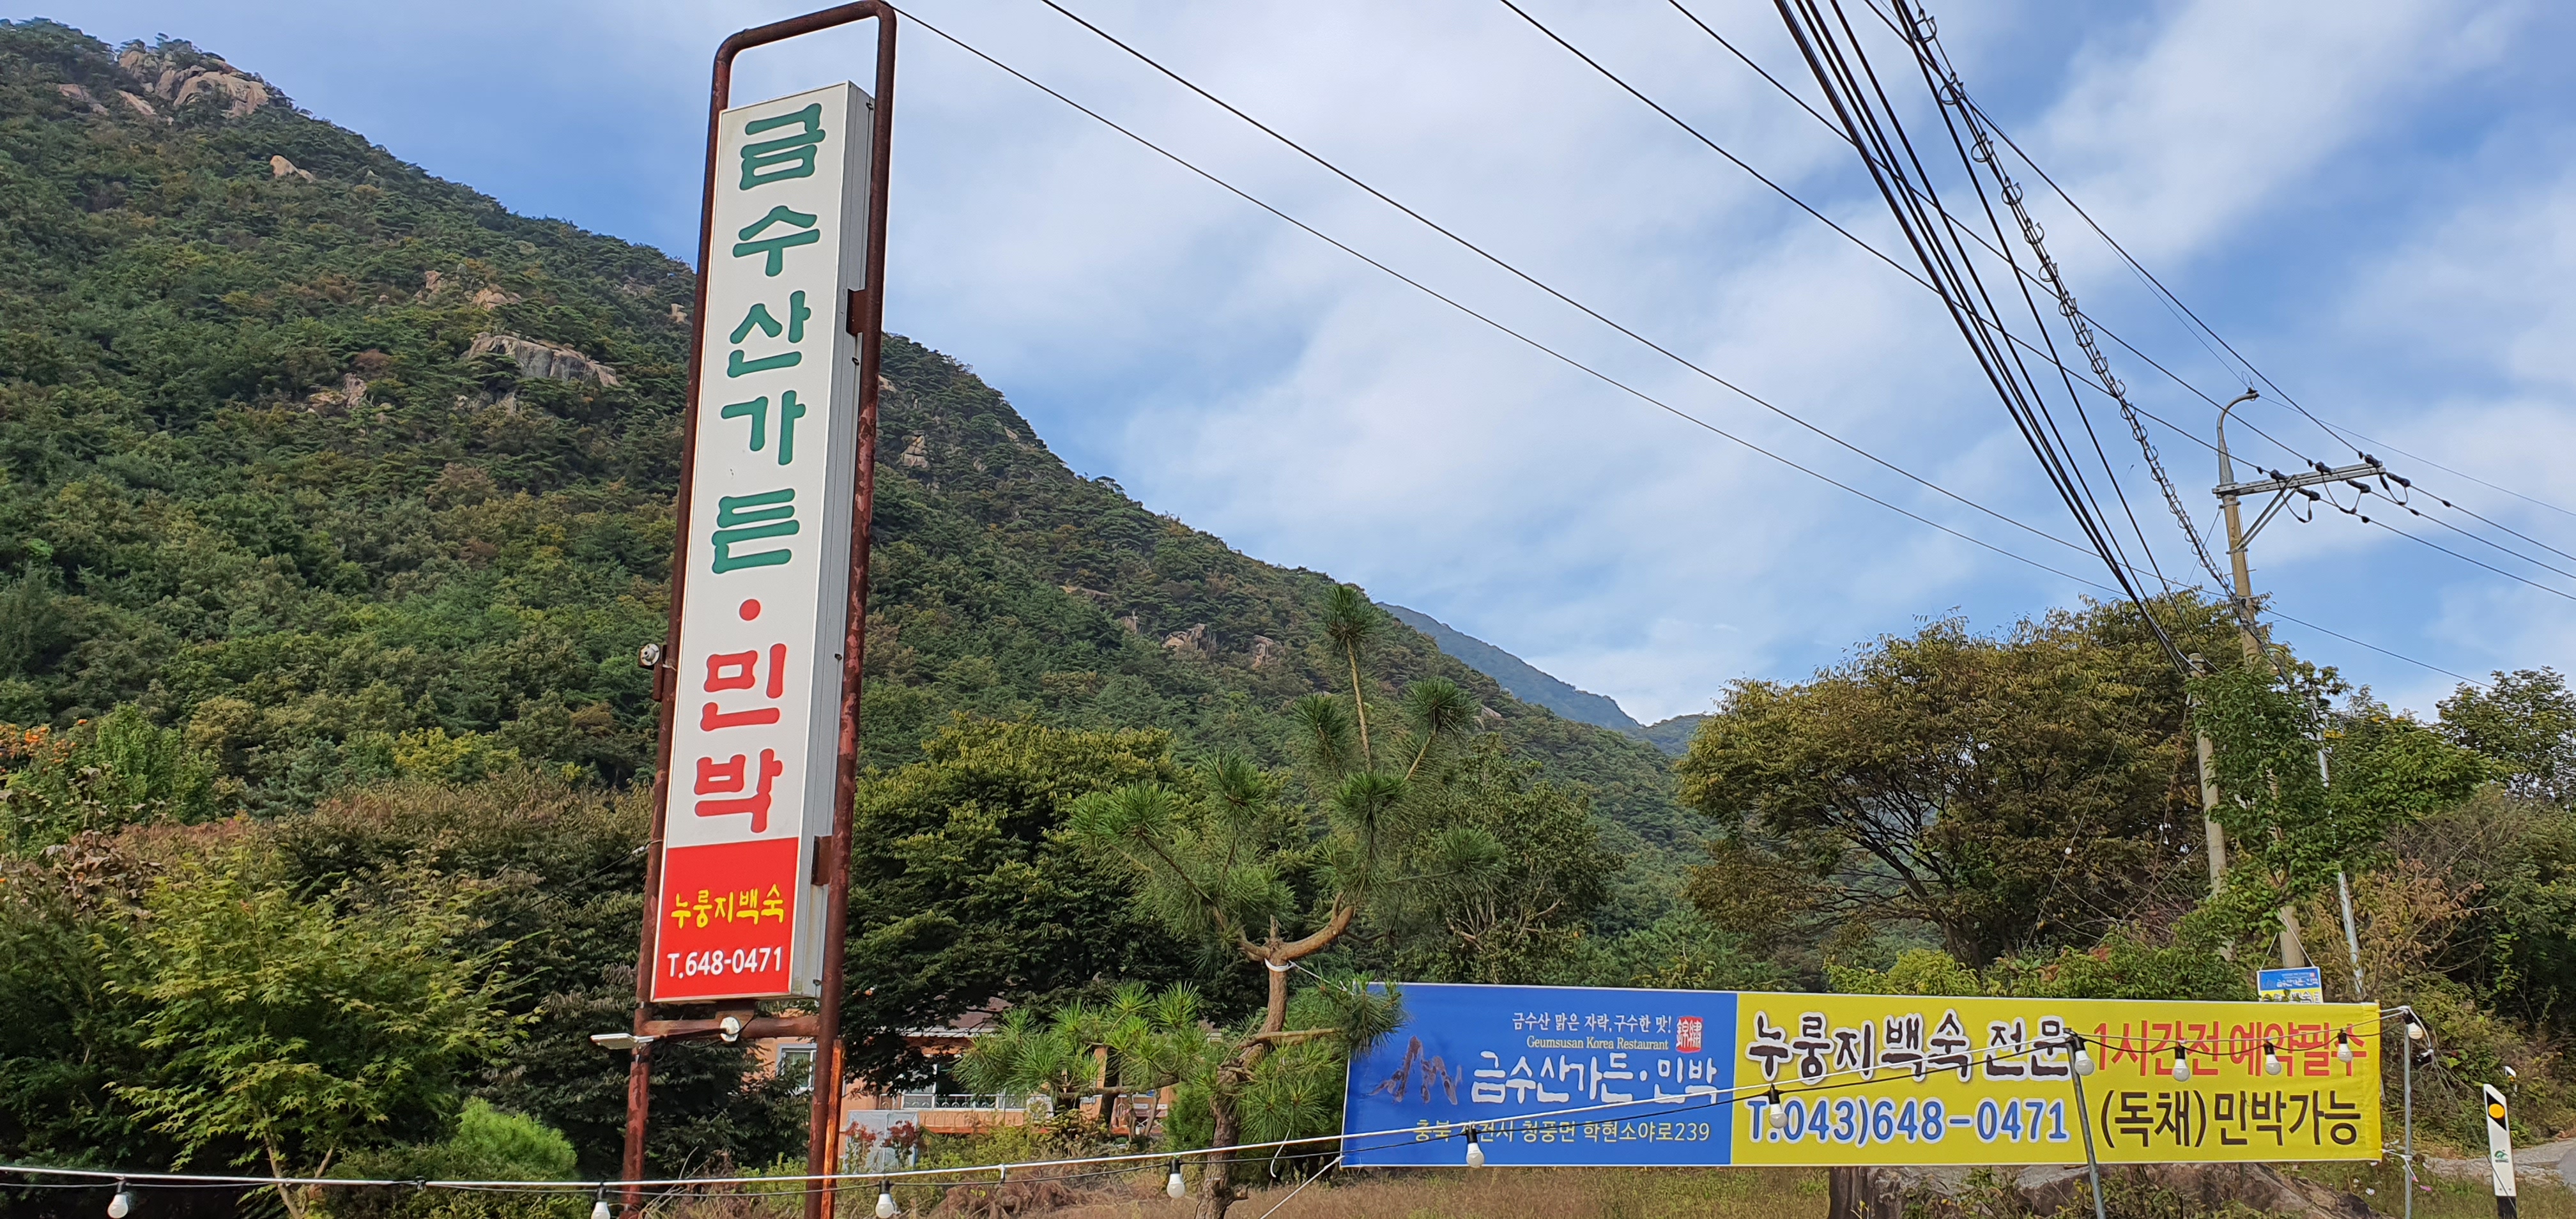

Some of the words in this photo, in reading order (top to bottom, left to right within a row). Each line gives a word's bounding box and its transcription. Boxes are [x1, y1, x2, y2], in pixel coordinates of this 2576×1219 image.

[671, 883, 785, 930] 누룽지백숙
[667, 946, 782, 979] T.648-0471
[1512, 1011, 1551, 1031] 금수산
[1555, 1012, 1580, 1032] 맑은
[1655, 1015, 1672, 1034] 맛!
[1526, 1035, 1584, 1049] Geumsusan
[1586, 1036, 1614, 1050] Korea
[1616, 1037, 1669, 1050] Restaurant
[1986, 1015, 2073, 1081] 전문
[2093, 1020, 2220, 1077] 1시간전
[2228, 1020, 2368, 1077] 예약필수
[1413, 1119, 1452, 1142] 충북
[1522, 1120, 1576, 1143] 청풍면
[1583, 1120, 1711, 1144] 학현소야로239
